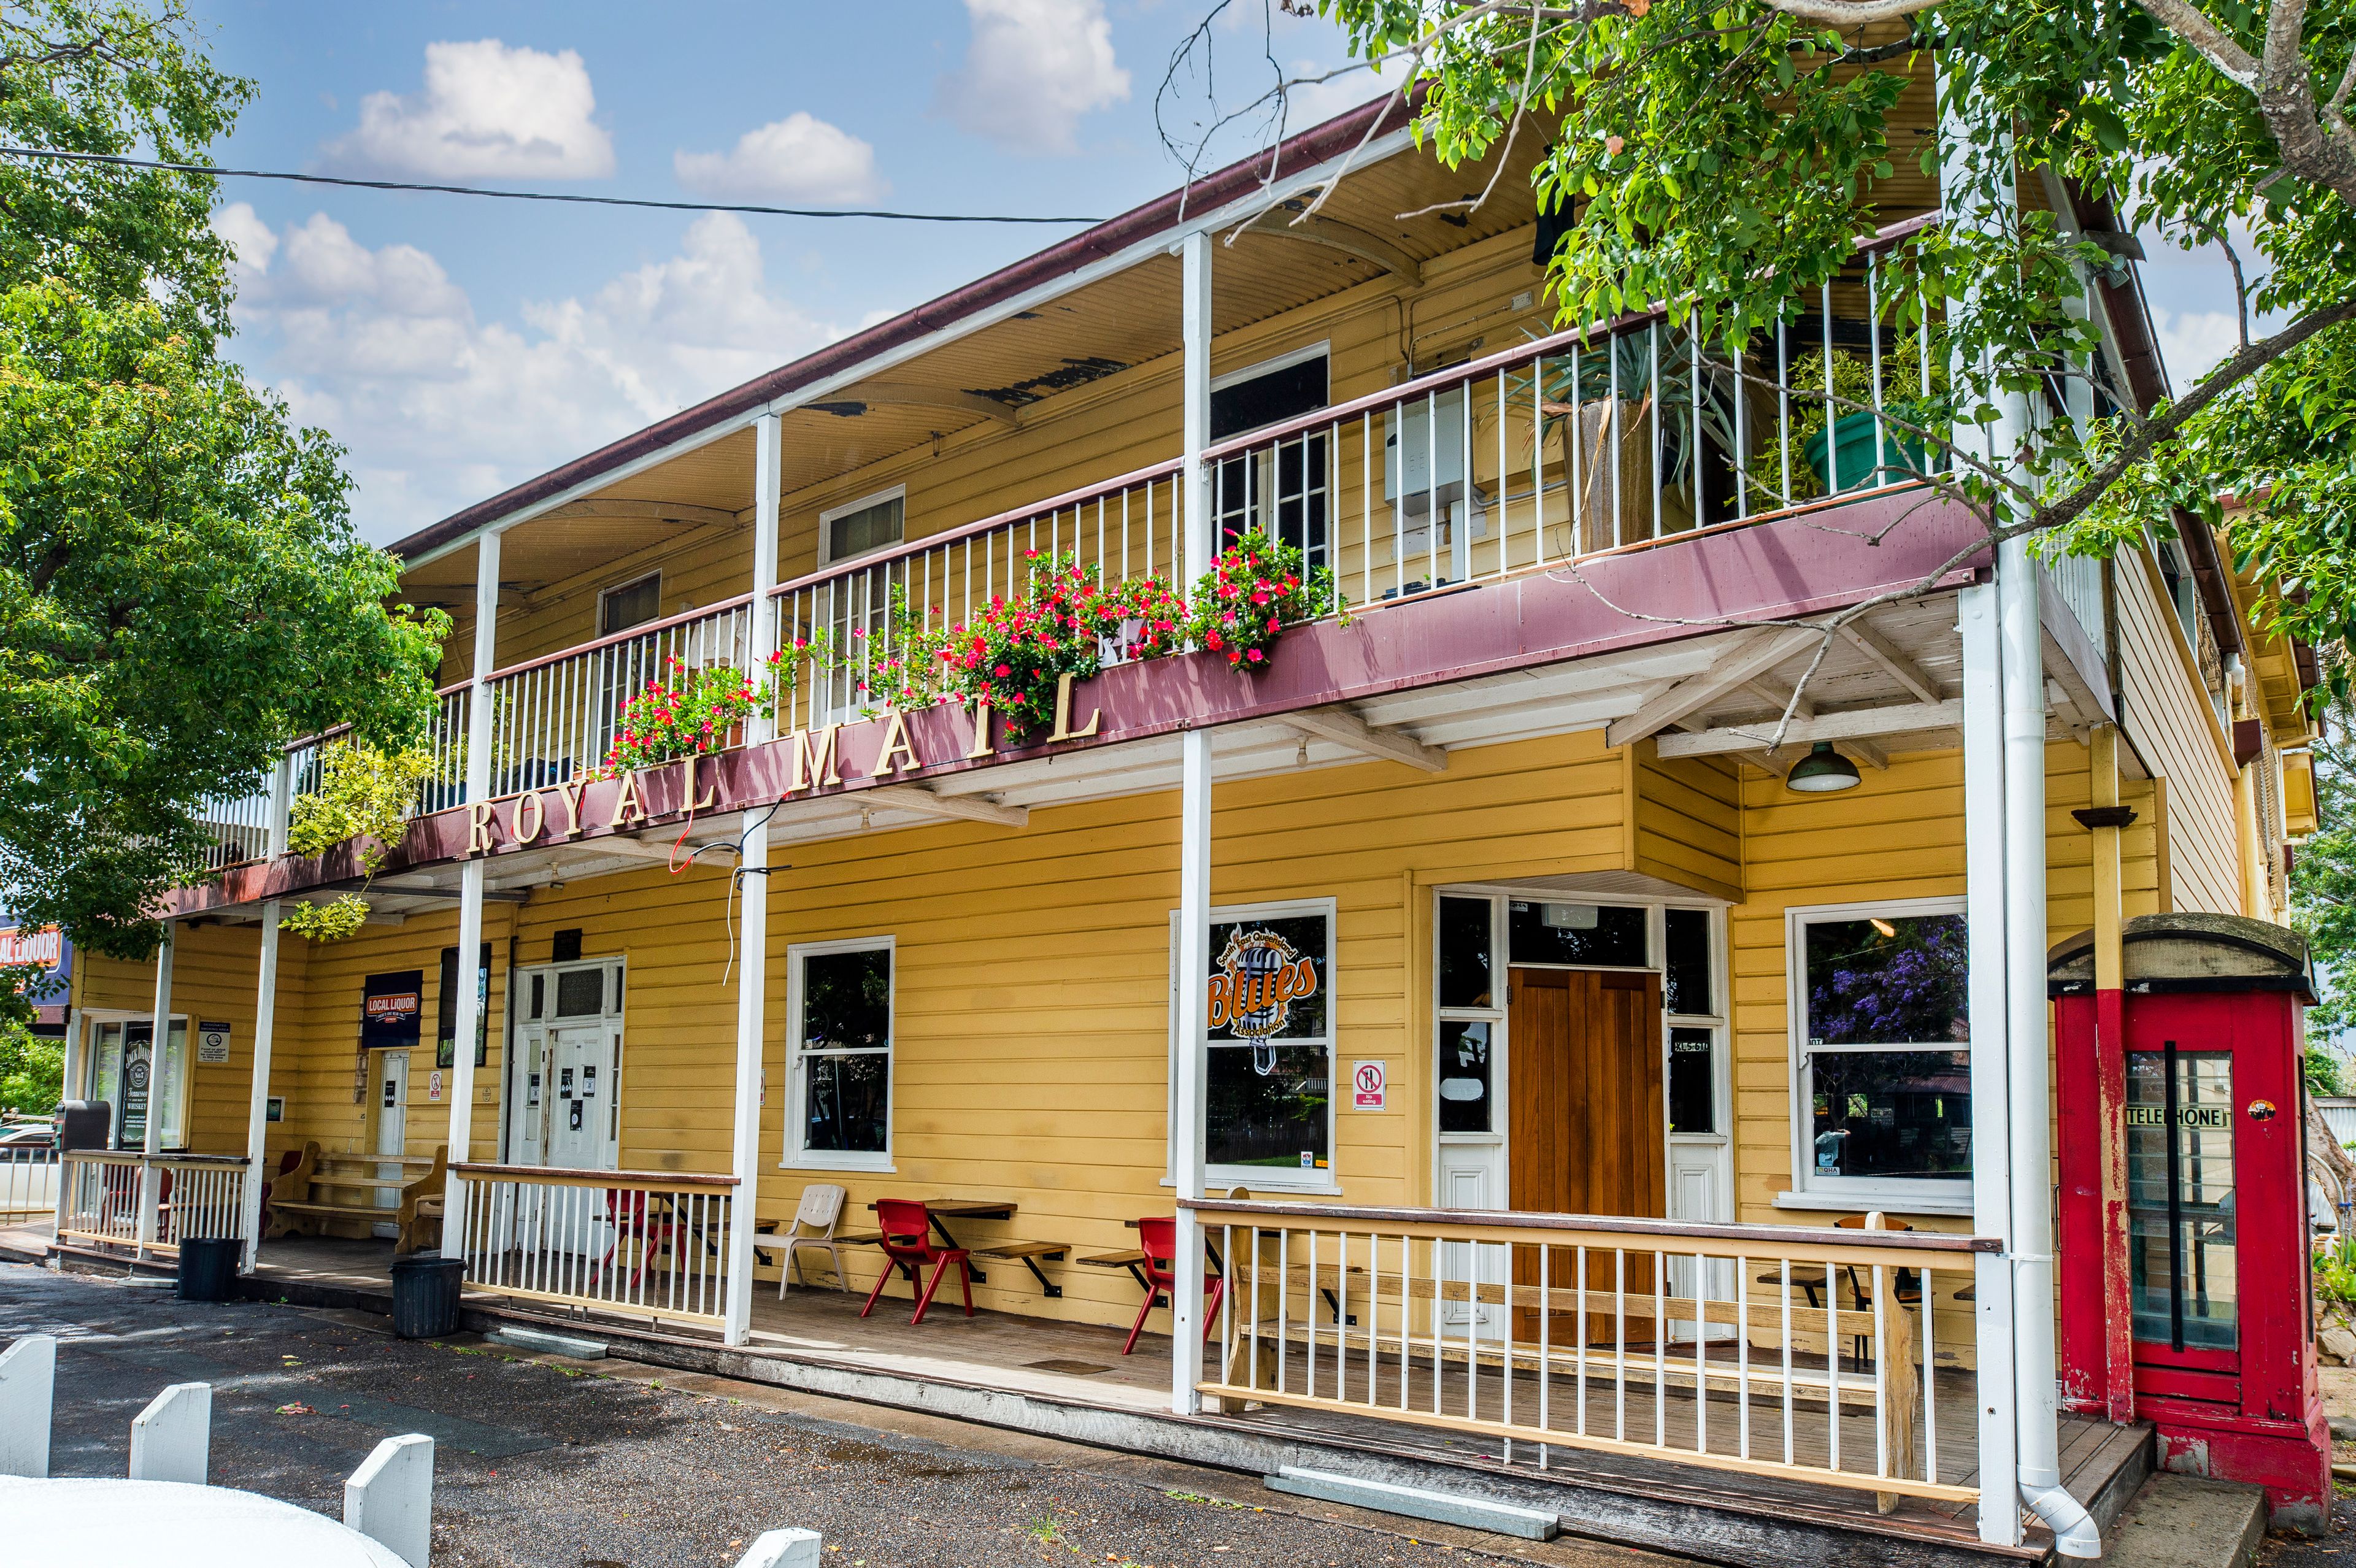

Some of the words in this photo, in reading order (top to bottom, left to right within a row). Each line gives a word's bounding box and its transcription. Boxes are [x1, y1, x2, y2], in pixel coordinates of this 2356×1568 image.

[466, 753, 715, 853] ROYAL
[788, 672, 1101, 791] MAIL
[1218, 943, 1236, 966] South
[1236, 935, 1252, 947] East
[1253, 932, 1297, 958] Queensland
[1207, 958, 1317, 1028] Blues
[369, 999, 390, 1011] LOCAL
[1233, 1019, 1286, 1037] Association
[126, 1048, 138, 1069] JACK
[138, 1043, 152, 1065] DANIE
[128, 1088, 148, 1097] Tennessee
[2126, 1108, 2220, 1126] TELEHONE
